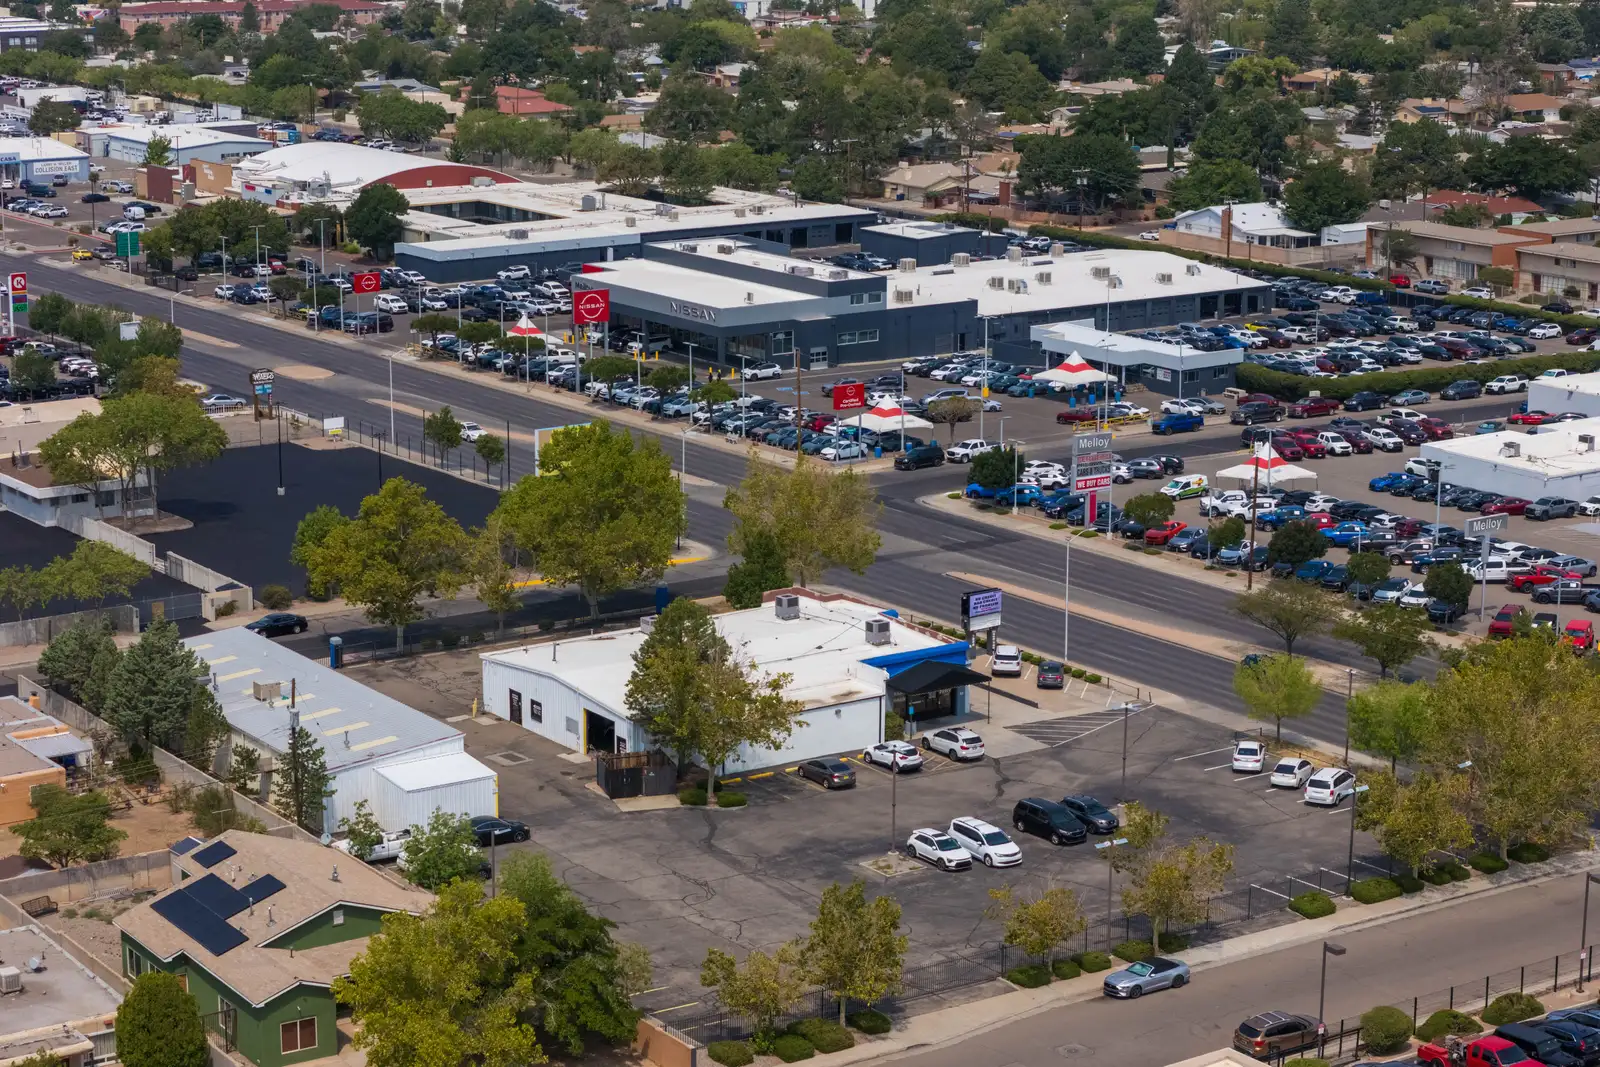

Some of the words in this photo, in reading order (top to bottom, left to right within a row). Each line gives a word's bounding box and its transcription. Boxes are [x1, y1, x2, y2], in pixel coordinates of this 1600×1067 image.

[35, 165, 63, 173] COLLISION
[64, 164, 78, 172] EAST
[579, 302, 605, 310] NISSAN
[670, 301, 717, 322] NISSAN
[1079, 437, 1110, 448] Melloy
[1077, 480, 1086, 489] WE
[1086, 479, 1096, 487] BUY
[1097, 478, 1111, 486] CARS
[1473, 518, 1502, 532] Melloy
